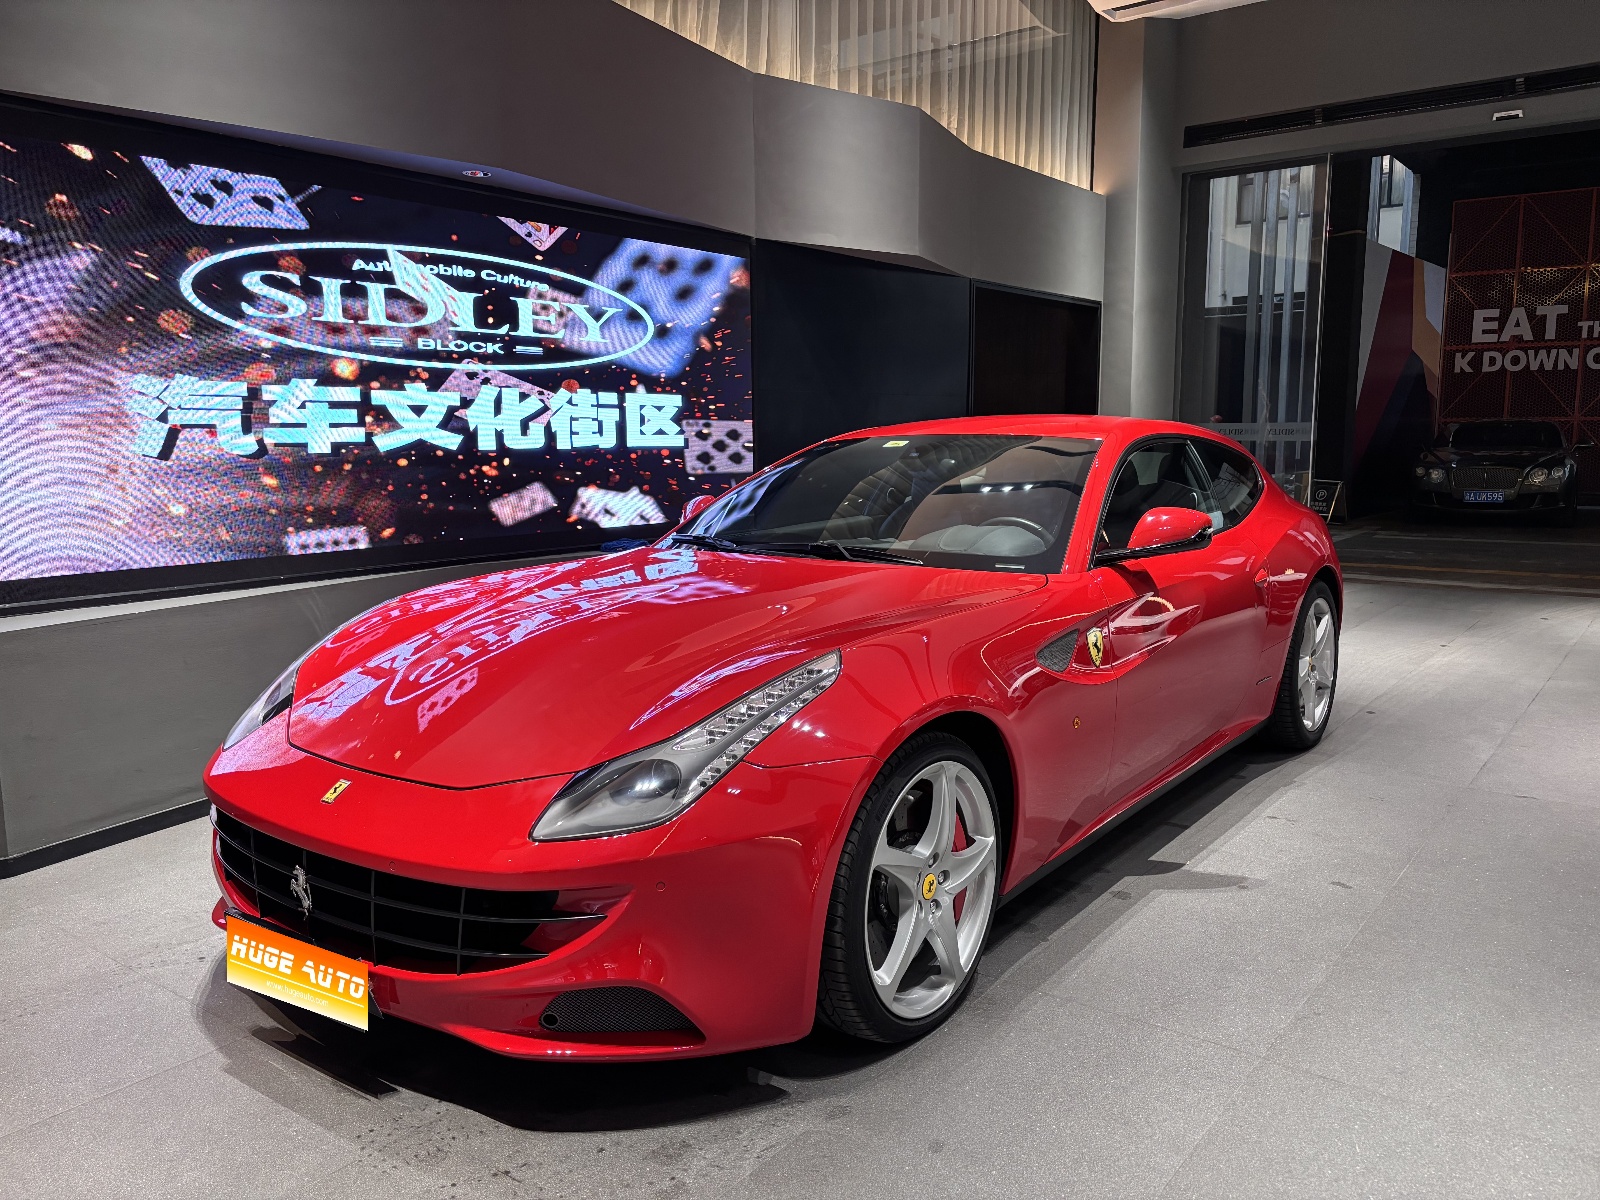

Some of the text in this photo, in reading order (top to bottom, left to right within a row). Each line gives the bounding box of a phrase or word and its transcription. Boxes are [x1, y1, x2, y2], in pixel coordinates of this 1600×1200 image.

[480, 269, 550, 292] Culture
[241, 269, 623, 343] SIDLEY
[1471, 304, 1569, 344] EAT
[417, 338, 504, 354] BLOCK
[1453, 351, 1476, 374] K
[1482, 347, 1580, 372] DOWN
[130, 371, 687, 459] 汽车文化街区
